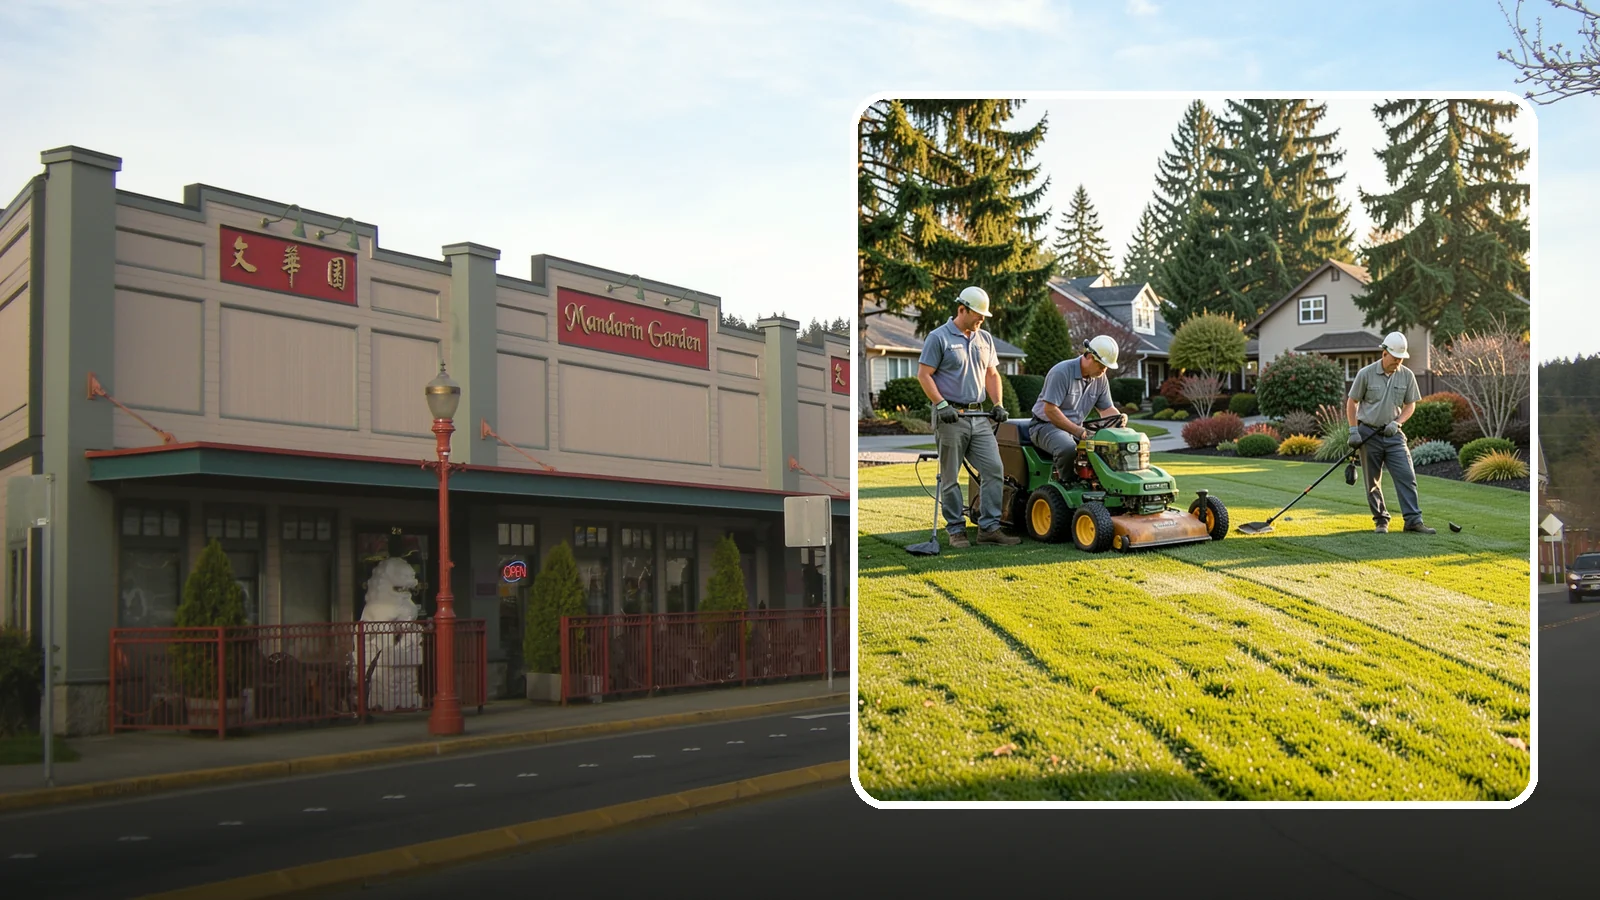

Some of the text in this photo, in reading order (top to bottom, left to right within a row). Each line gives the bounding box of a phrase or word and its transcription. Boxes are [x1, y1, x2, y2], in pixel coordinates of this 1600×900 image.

[230, 235, 346, 291] 文華園
[564, 302, 702, 352] Mandarin Garden
[503, 565, 527, 578] OPEN
